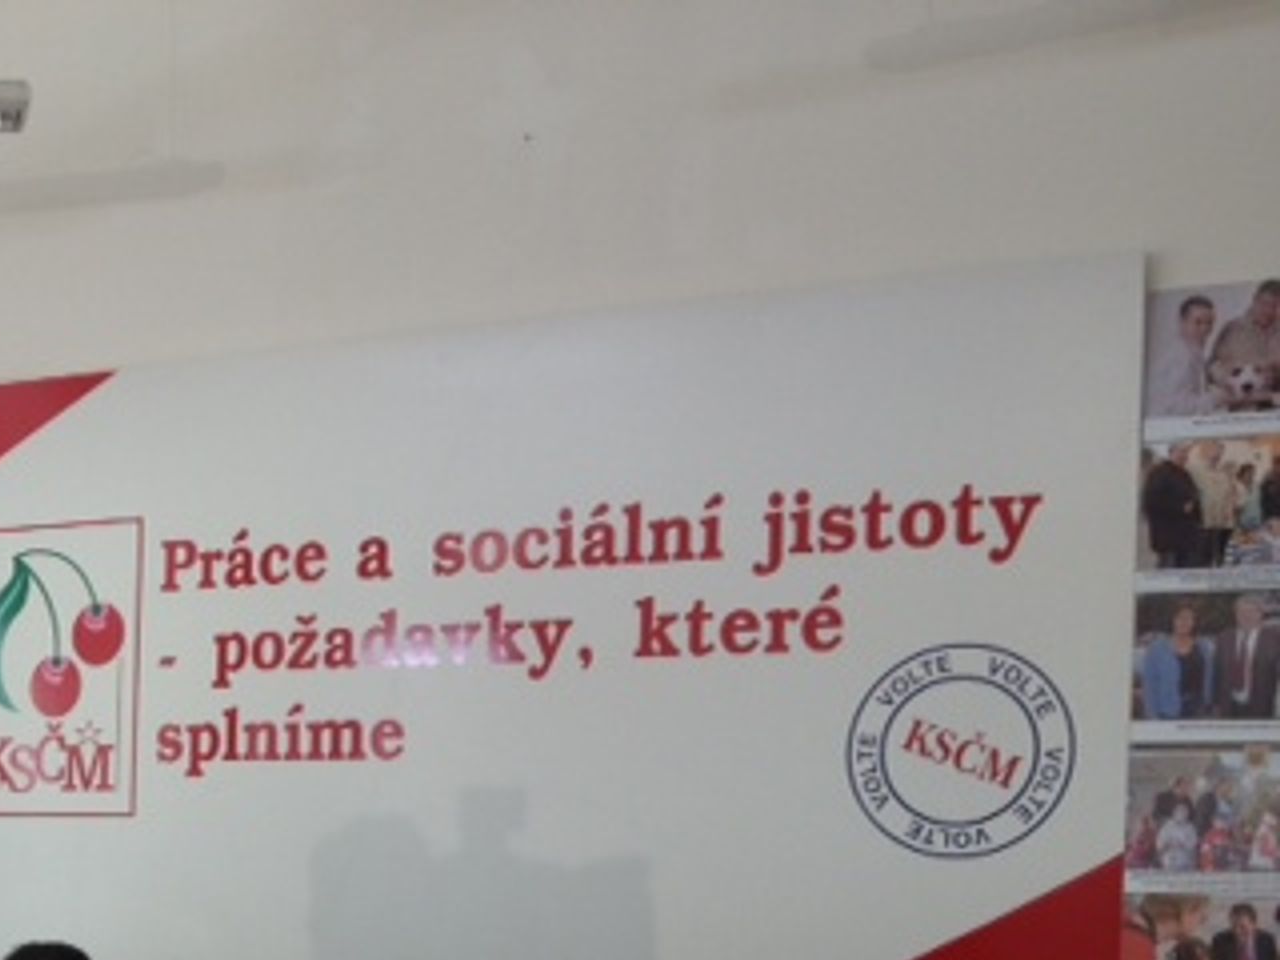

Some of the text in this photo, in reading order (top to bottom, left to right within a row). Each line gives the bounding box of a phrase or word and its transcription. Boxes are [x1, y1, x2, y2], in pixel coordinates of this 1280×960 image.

[160, 484, 1043, 592] Práce a sociální jistoty
[213, 604, 594, 688] požadavky,
[634, 585, 845, 658] které
[876, 652, 953, 709] VOLTE
[987, 656, 1057, 719] VOLTE
[156, 703, 405, 776] splníme
[856, 733, 890, 812] VOLTE
[902, 718, 1024, 789] KSČM
[1013, 746, 1065, 825] VOLTE
[904, 820, 991, 850] VOLTE
